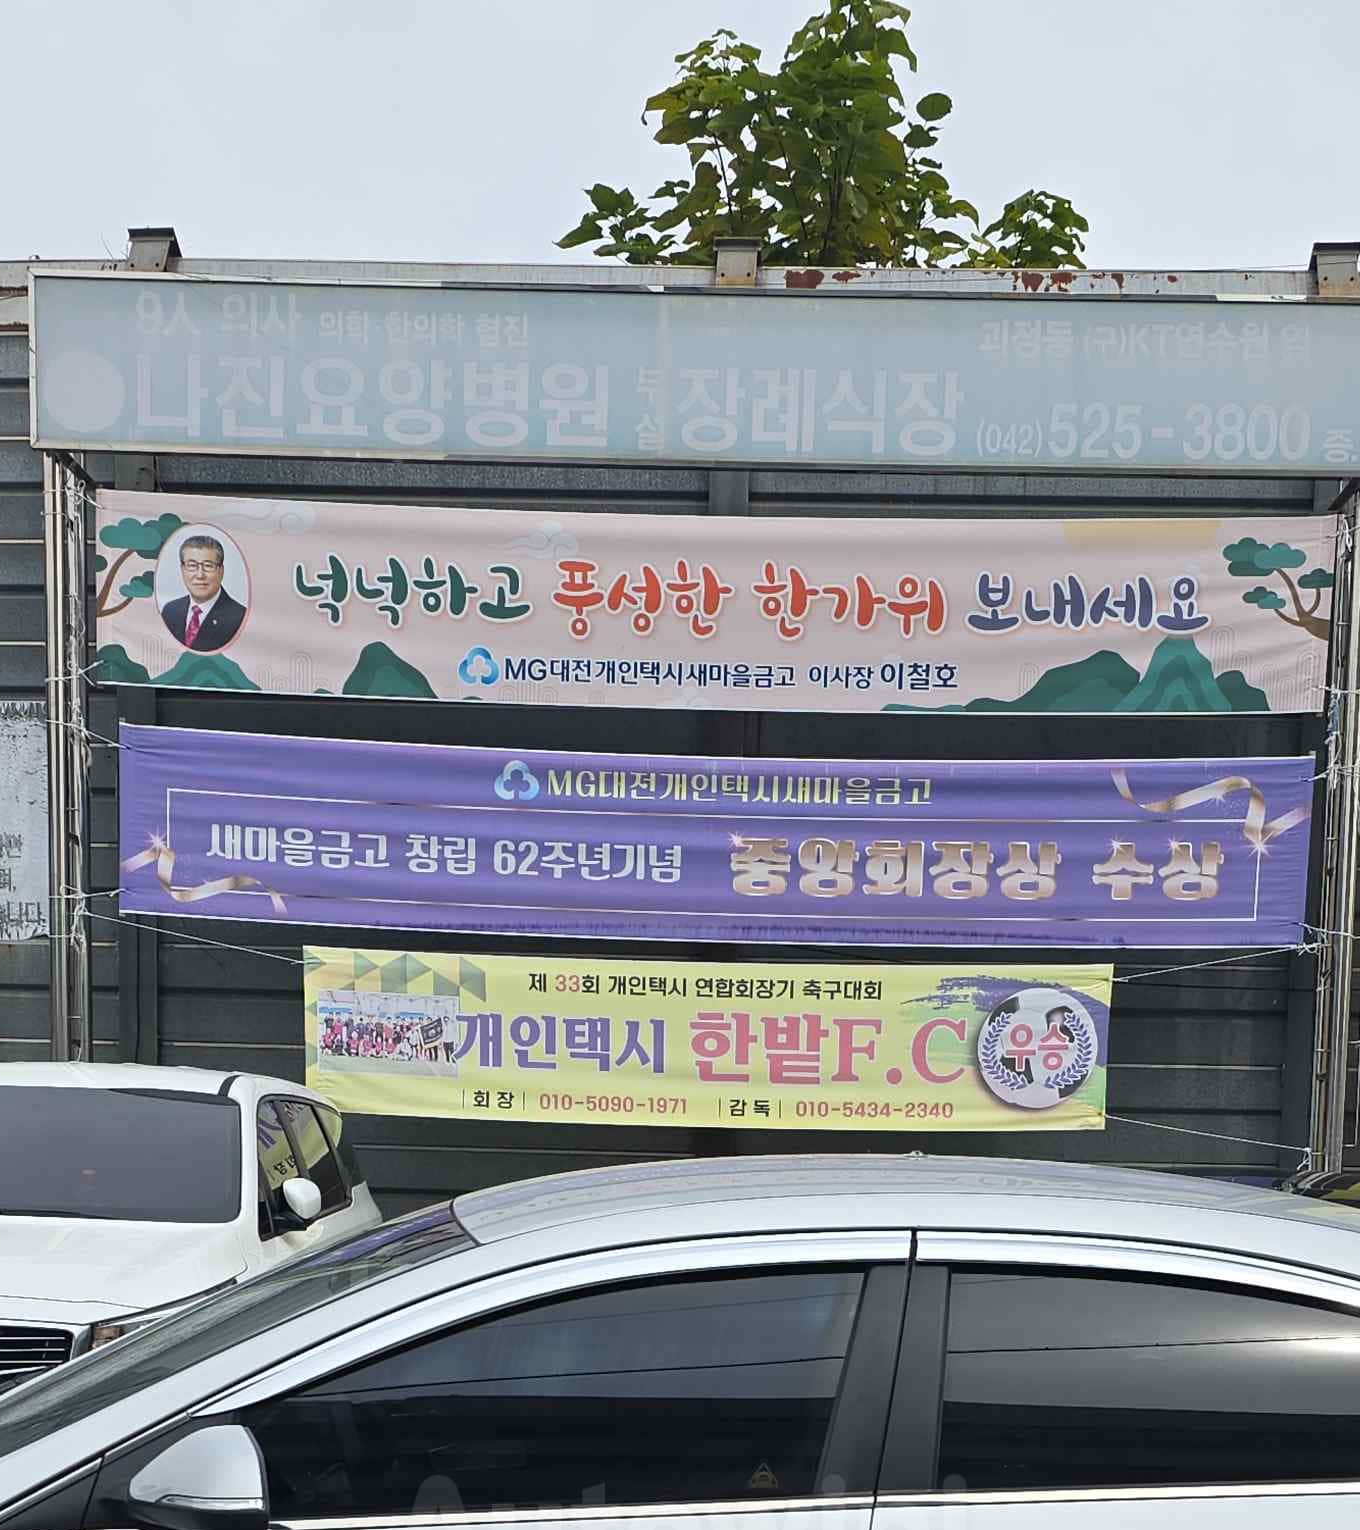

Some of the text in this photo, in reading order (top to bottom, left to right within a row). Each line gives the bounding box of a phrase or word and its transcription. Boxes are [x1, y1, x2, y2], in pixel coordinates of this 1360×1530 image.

[221, 293, 303, 343] 의사
[978, 319, 1075, 361] 괴정동
[136, 351, 610, 448] 나진요양병원
[677, 367, 964, 457] 장례식장
[296, 553, 1210, 640] 넉넉하고 풍성한 한가위 보내세요
[504, 657, 959, 691] MG대전개인택시새마을금고 이사장 이철호
[545, 768, 932, 807] MG대전개인택시새마을금고
[206, 823, 1225, 901] 새마을금고 창립 62주년기념 중앙회장상 수상
[528, 973, 883, 1001] 제 33회 개인택시 연합회장기 축구대회
[455, 1012, 665, 1074] 개인택시
[1005, 1022, 1070, 1072] 우승
[539, 1093, 688, 1116] 010-5090-1971
[795, 1100, 954, 1119] 010-5434-2340
